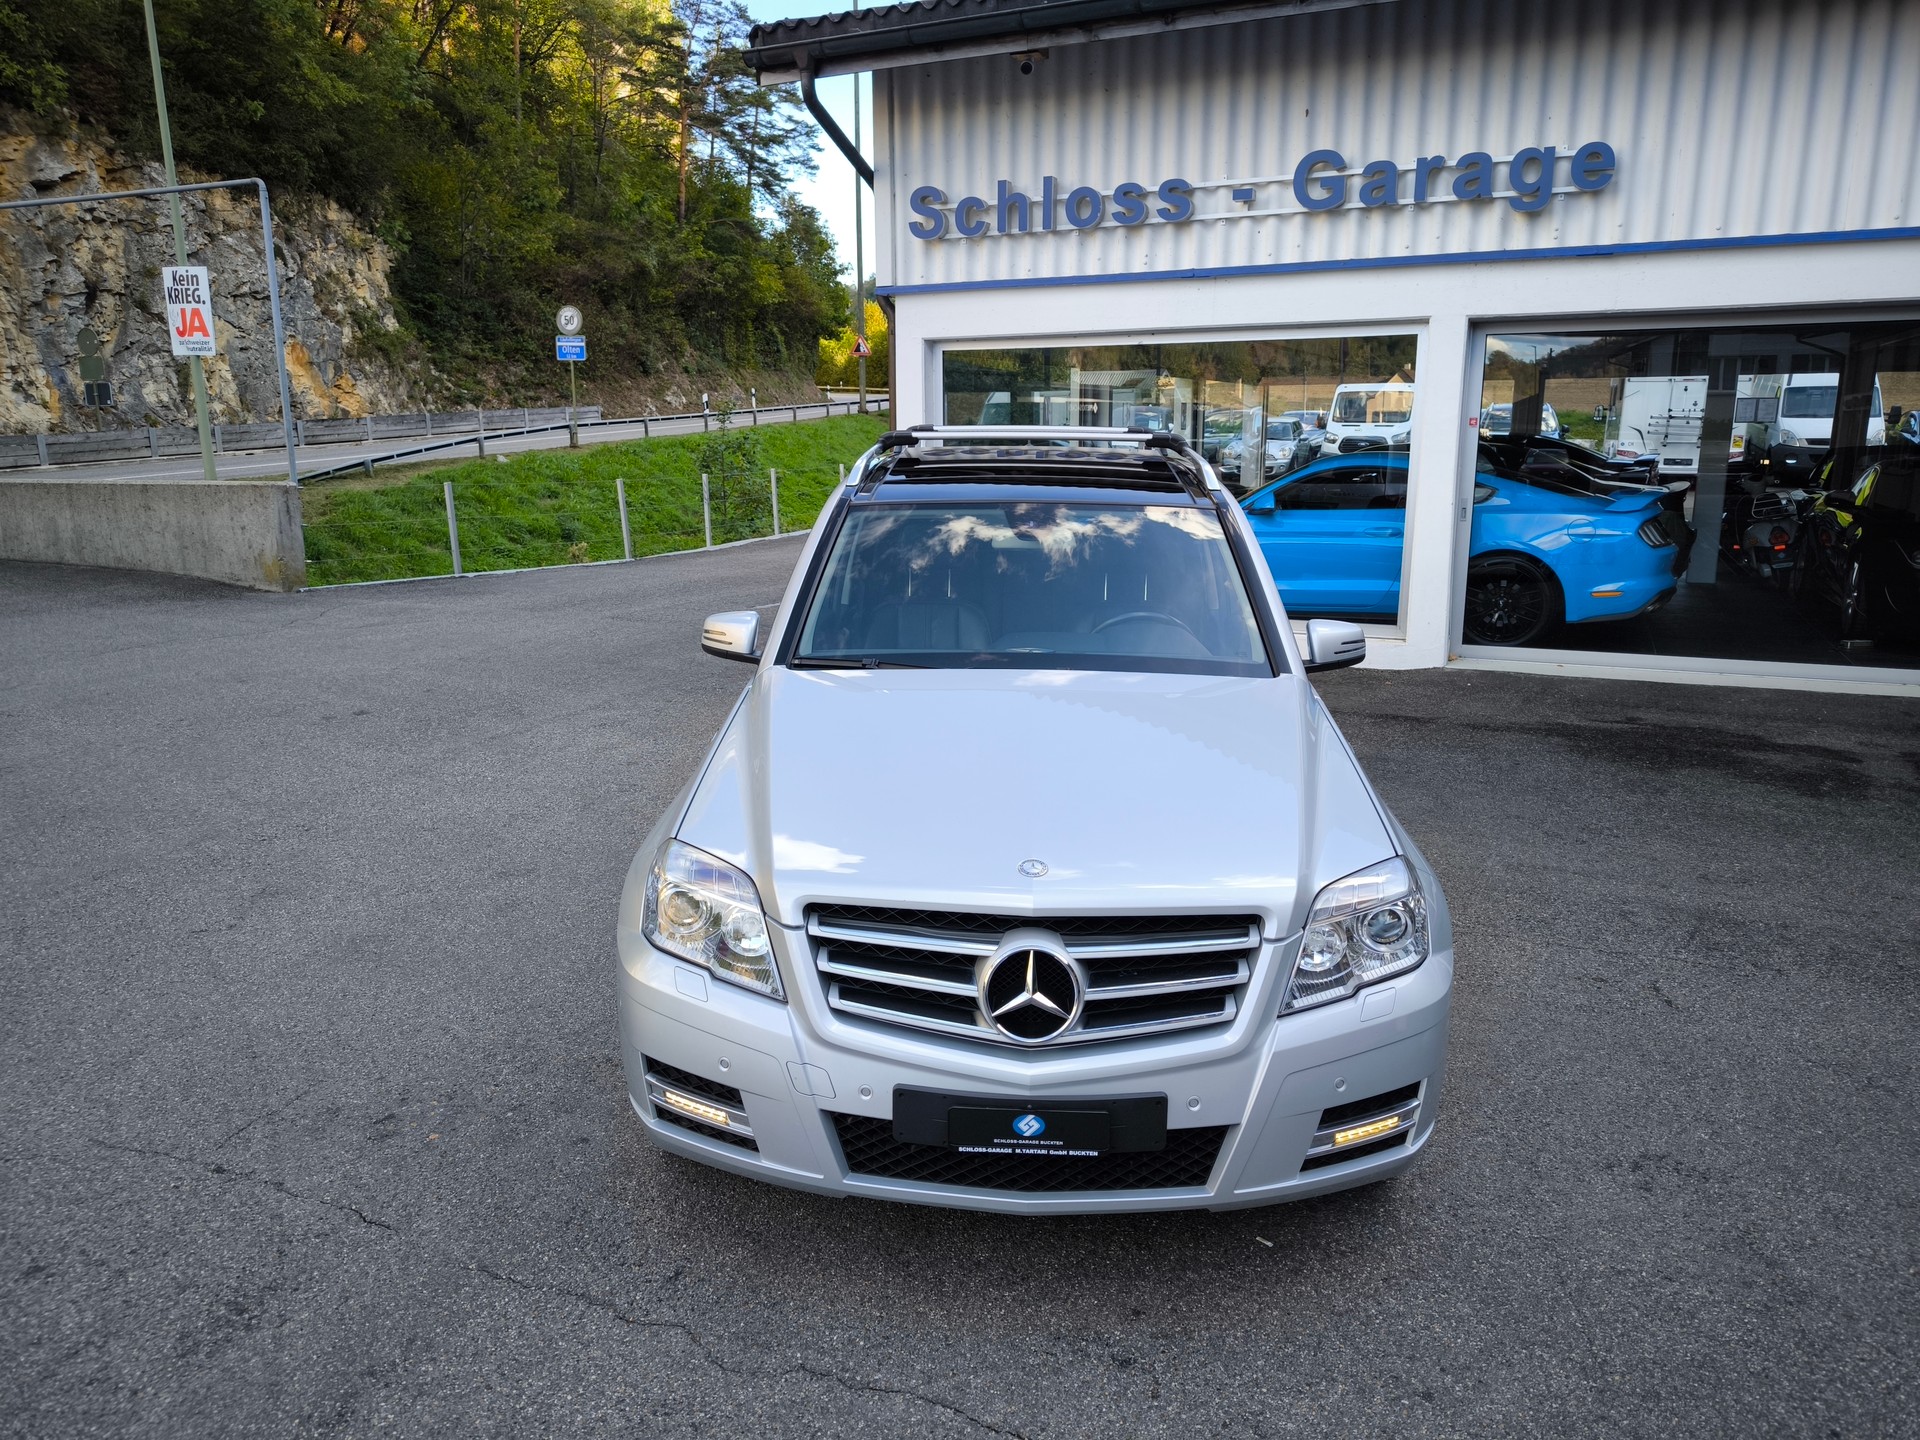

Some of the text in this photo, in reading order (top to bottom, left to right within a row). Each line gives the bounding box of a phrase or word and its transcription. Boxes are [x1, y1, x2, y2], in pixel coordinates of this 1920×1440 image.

[908, 175, 1194, 241] Schloss
[1292, 141, 1616, 213] Garage
[171, 269, 200, 287] Kein
[167, 286, 206, 305] KRIEG.
[175, 307, 210, 338] JA
[564, 315, 575, 326] 50
[561, 346, 581, 354] Olten
[958, 1146, 1013, 1154] SCHLOSS-GARAGE
